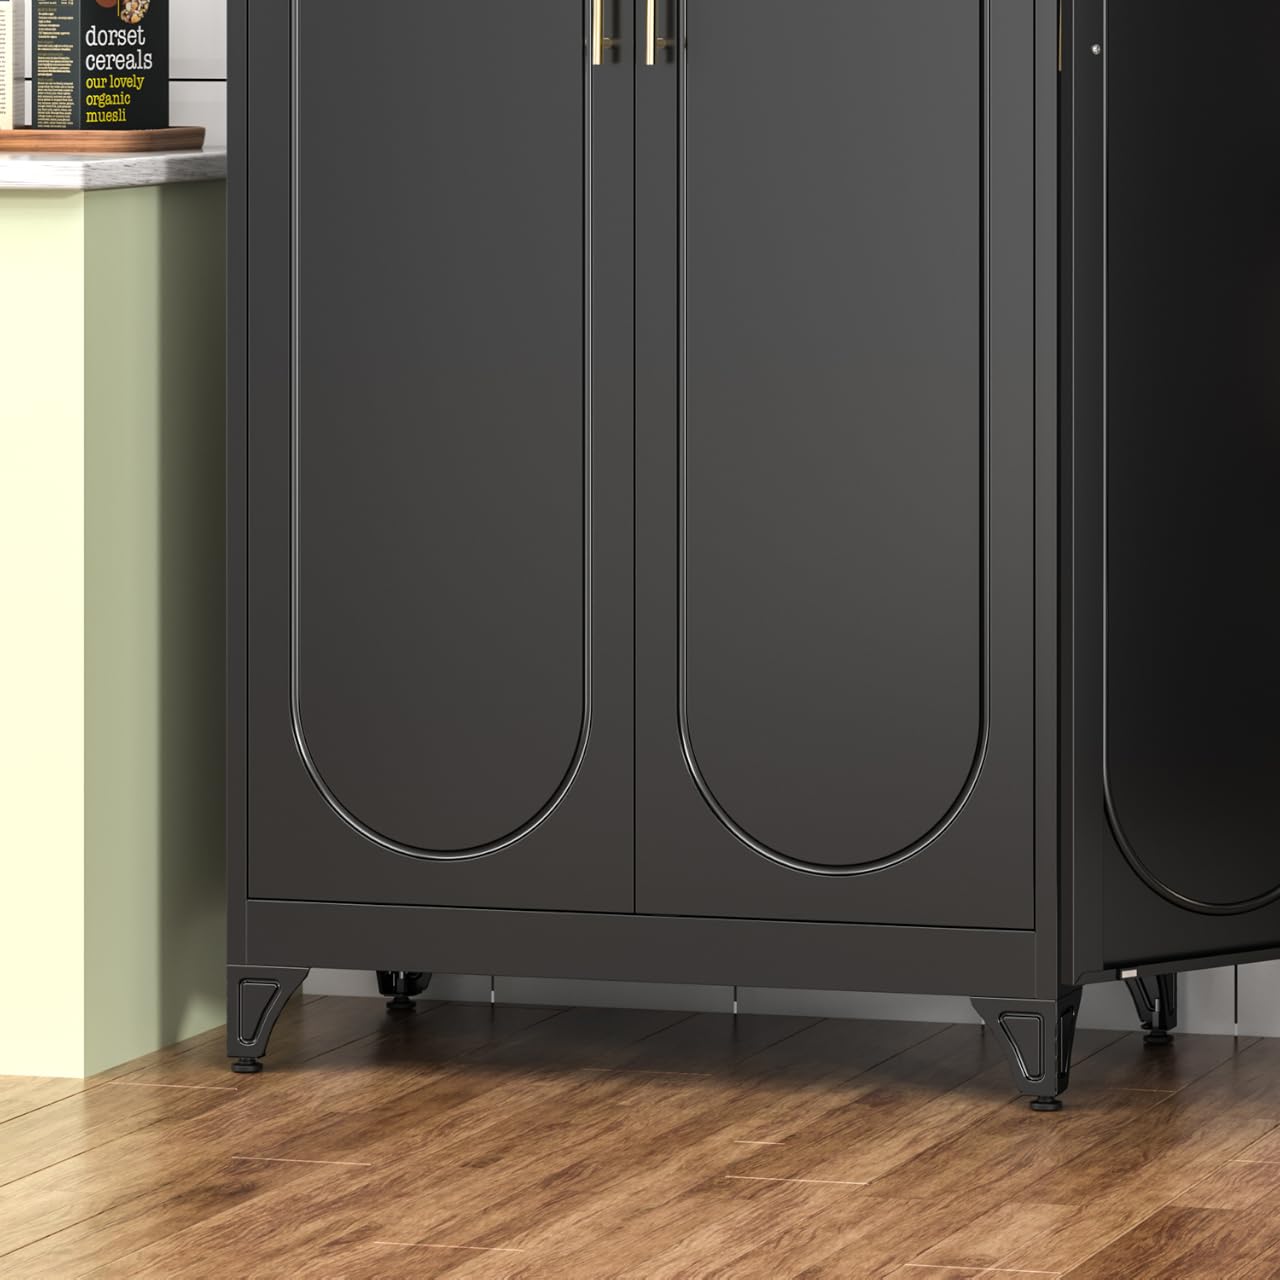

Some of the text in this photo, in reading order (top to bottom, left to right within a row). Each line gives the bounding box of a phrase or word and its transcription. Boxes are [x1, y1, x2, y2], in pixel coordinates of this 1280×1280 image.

[85, 25, 146, 46] dorset
[85, 48, 152, 70] cereals
[86, 74, 144, 90] our lovely
[86, 92, 131, 108] organic
[86, 108, 127, 122] muesli
